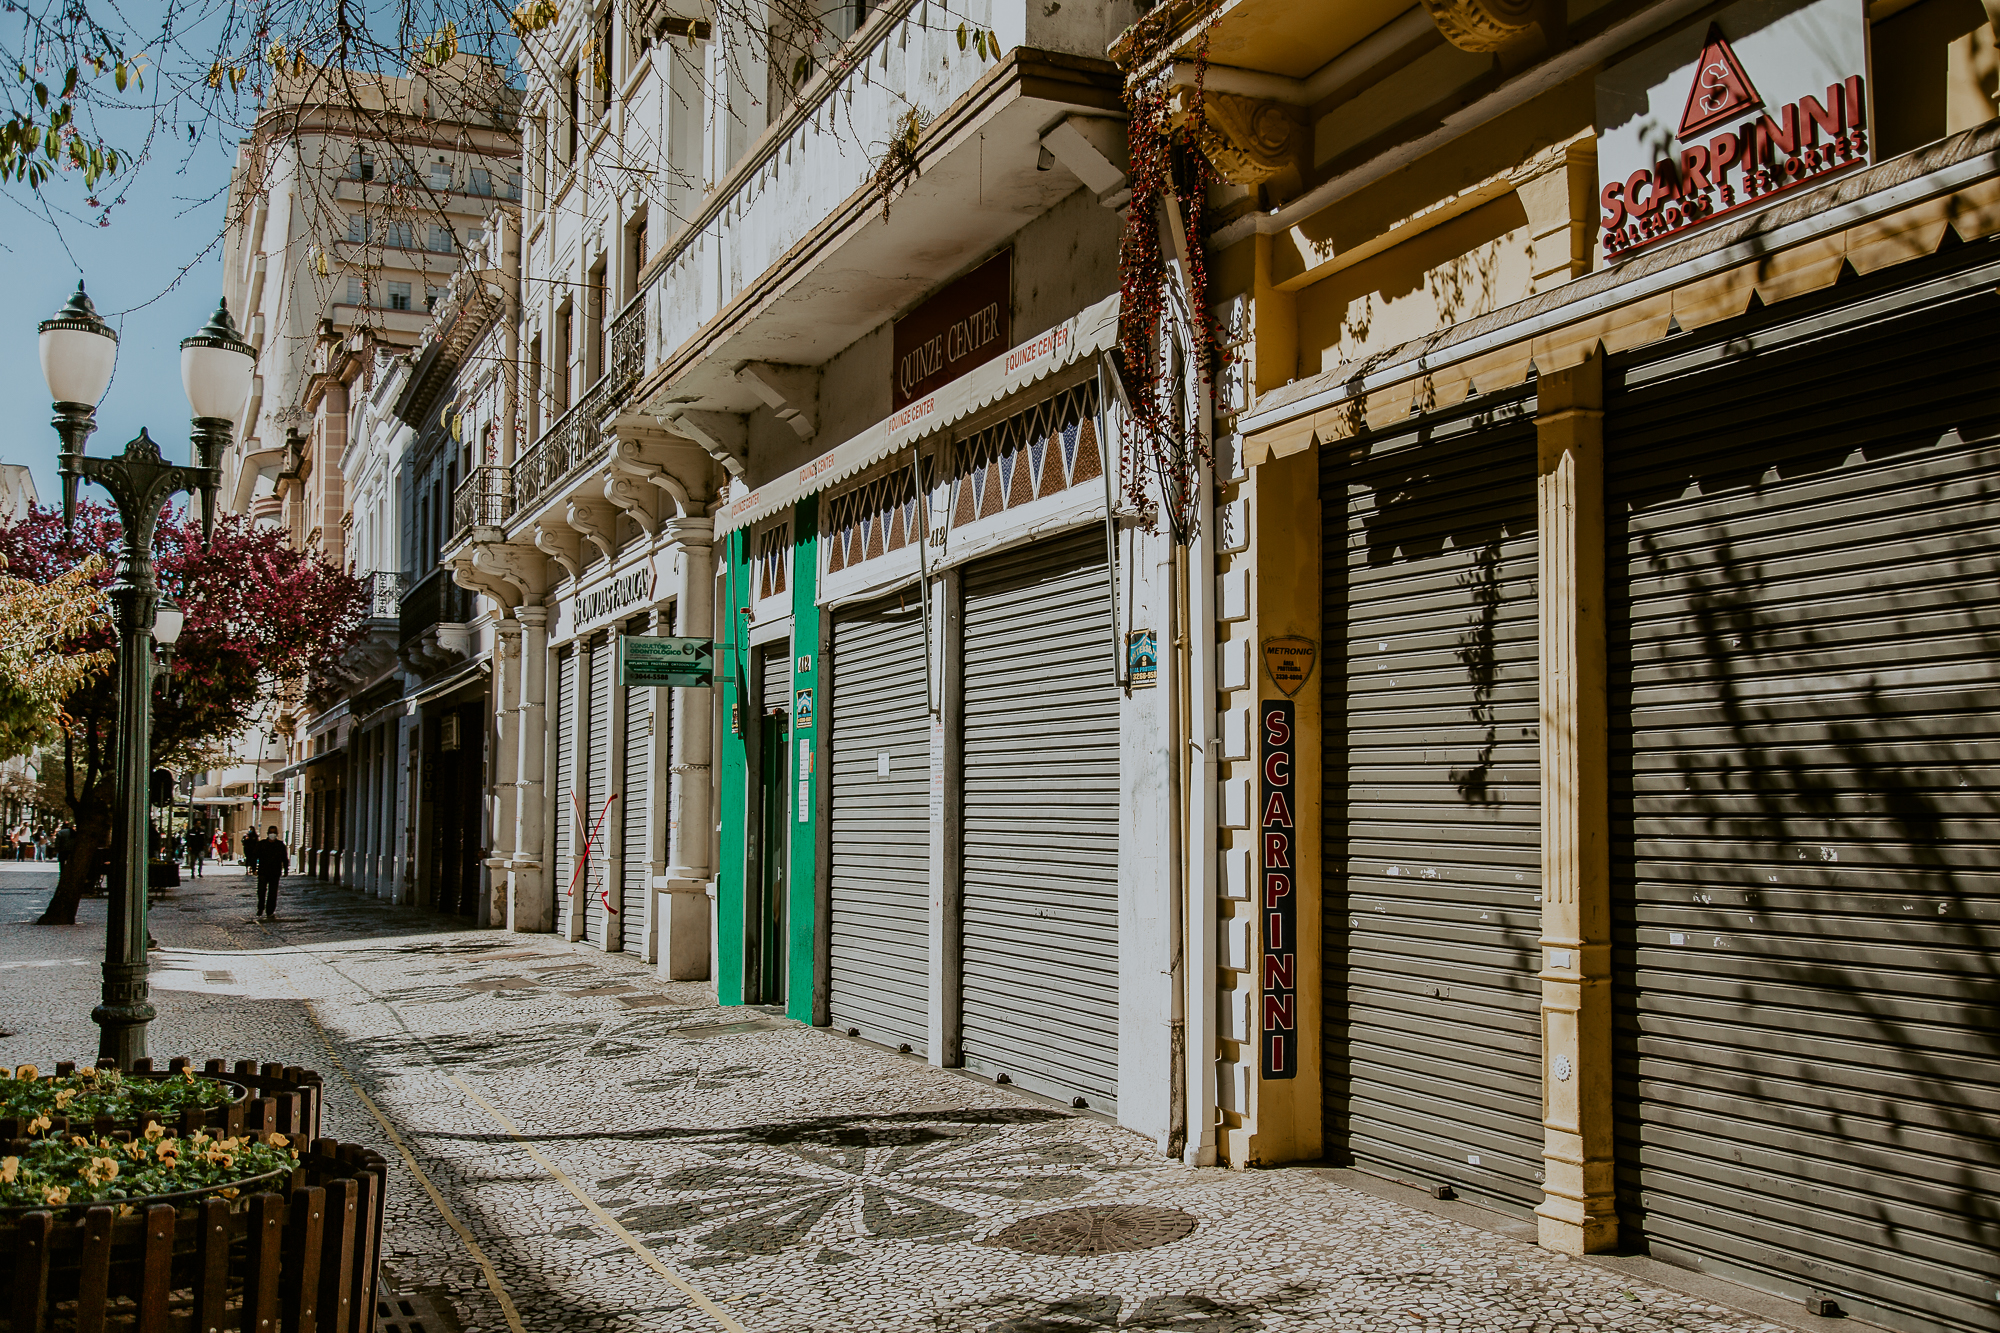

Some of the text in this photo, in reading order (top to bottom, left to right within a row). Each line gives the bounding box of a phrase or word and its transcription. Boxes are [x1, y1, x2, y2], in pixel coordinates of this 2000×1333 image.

[1699, 58, 1729, 116] S
[1601, 75, 1867, 229] SCARPINNI
[1602, 130, 1867, 250] CALÇADOS E ESPORTES
[900, 302, 1000, 400] QUINZE CENTER
[1010, 343, 1037, 371] QUINZE
[1038, 327, 1068, 357] CENTER
[892, 409, 911, 432] QUINZE
[912, 397, 934, 421] CENTER
[818, 453, 834, 474] CENTER
[629, 648, 682, 656] ODONTOLÓGICO
[1267, 646, 1313, 656] METRONIC
[1263, 710, 1294, 1072] SCARPINNI
